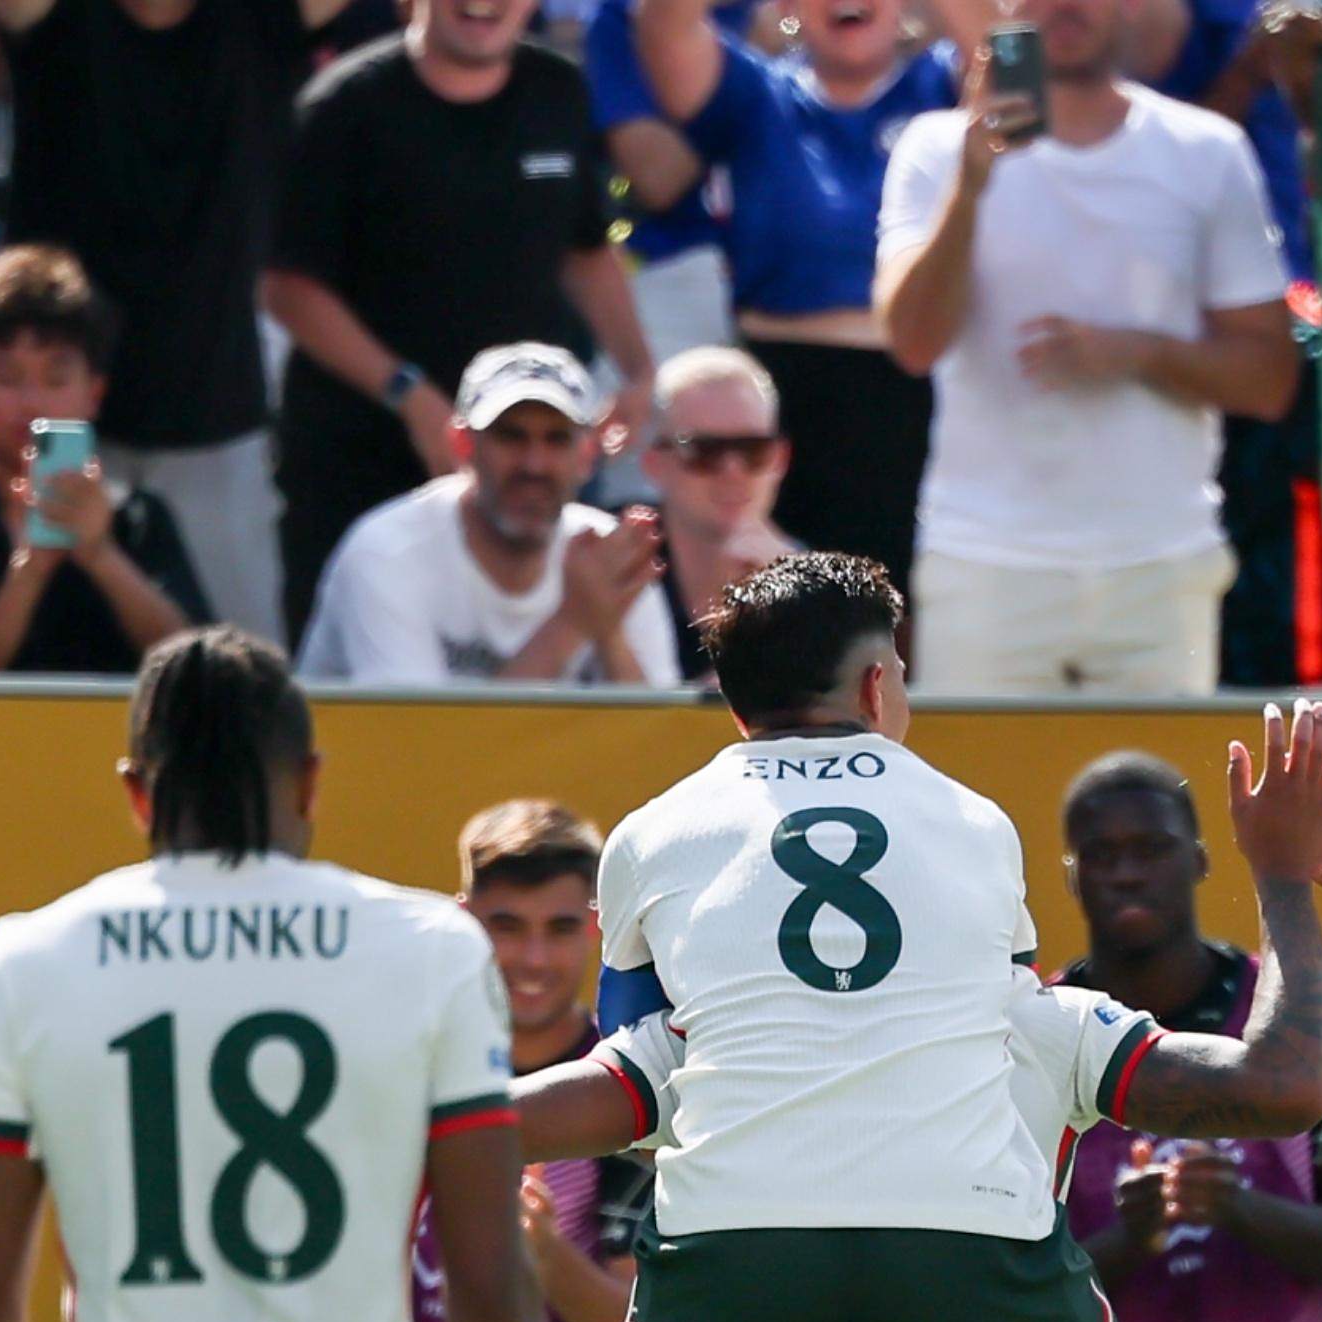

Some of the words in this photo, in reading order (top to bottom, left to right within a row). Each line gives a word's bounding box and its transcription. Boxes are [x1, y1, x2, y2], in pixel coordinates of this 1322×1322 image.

[743, 751, 886, 780] ENZO
[97, 903, 350, 967] NKUNKU
[770, 806, 903, 993] 8
[107, 1008, 347, 1289] 18
